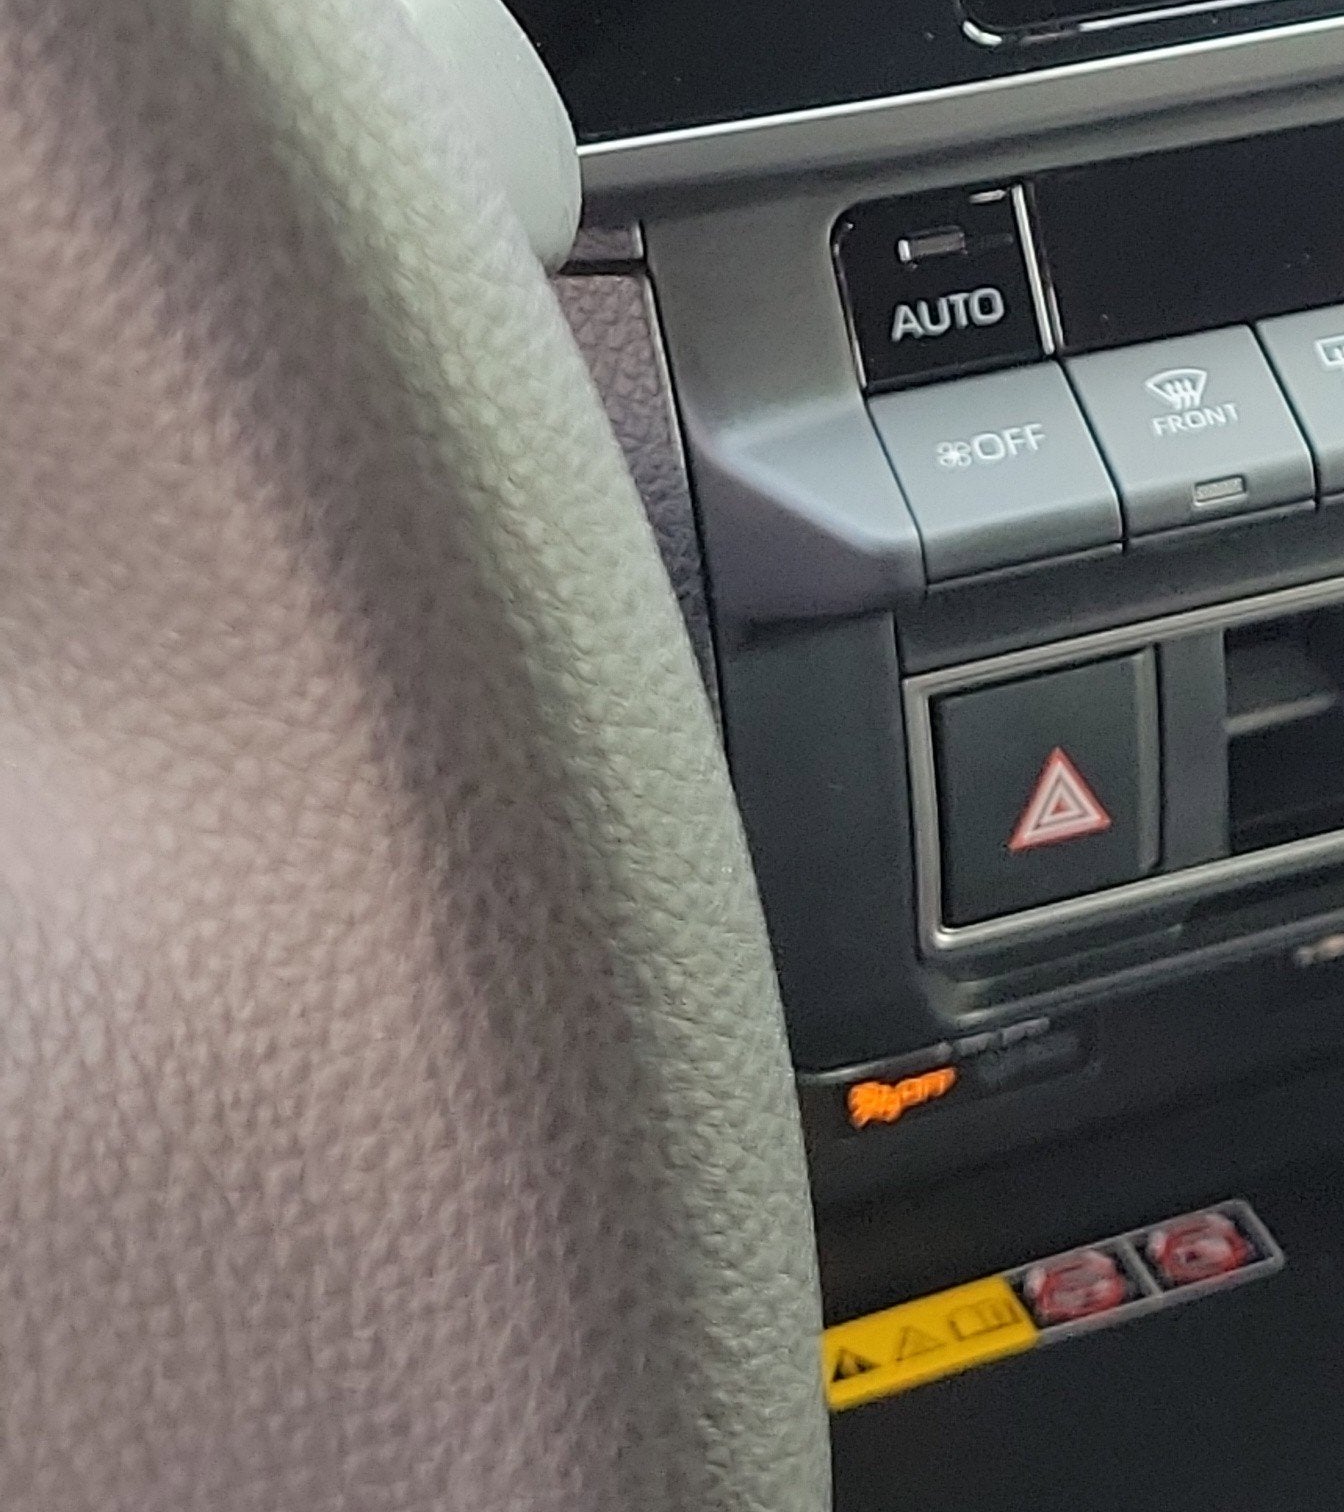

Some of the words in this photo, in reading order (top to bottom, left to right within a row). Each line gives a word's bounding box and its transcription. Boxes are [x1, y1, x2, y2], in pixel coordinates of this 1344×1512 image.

[891, 287, 1005, 342] AUTO
[1152, 402, 1239, 435] FRONT
[971, 423, 1046, 460] OFF
